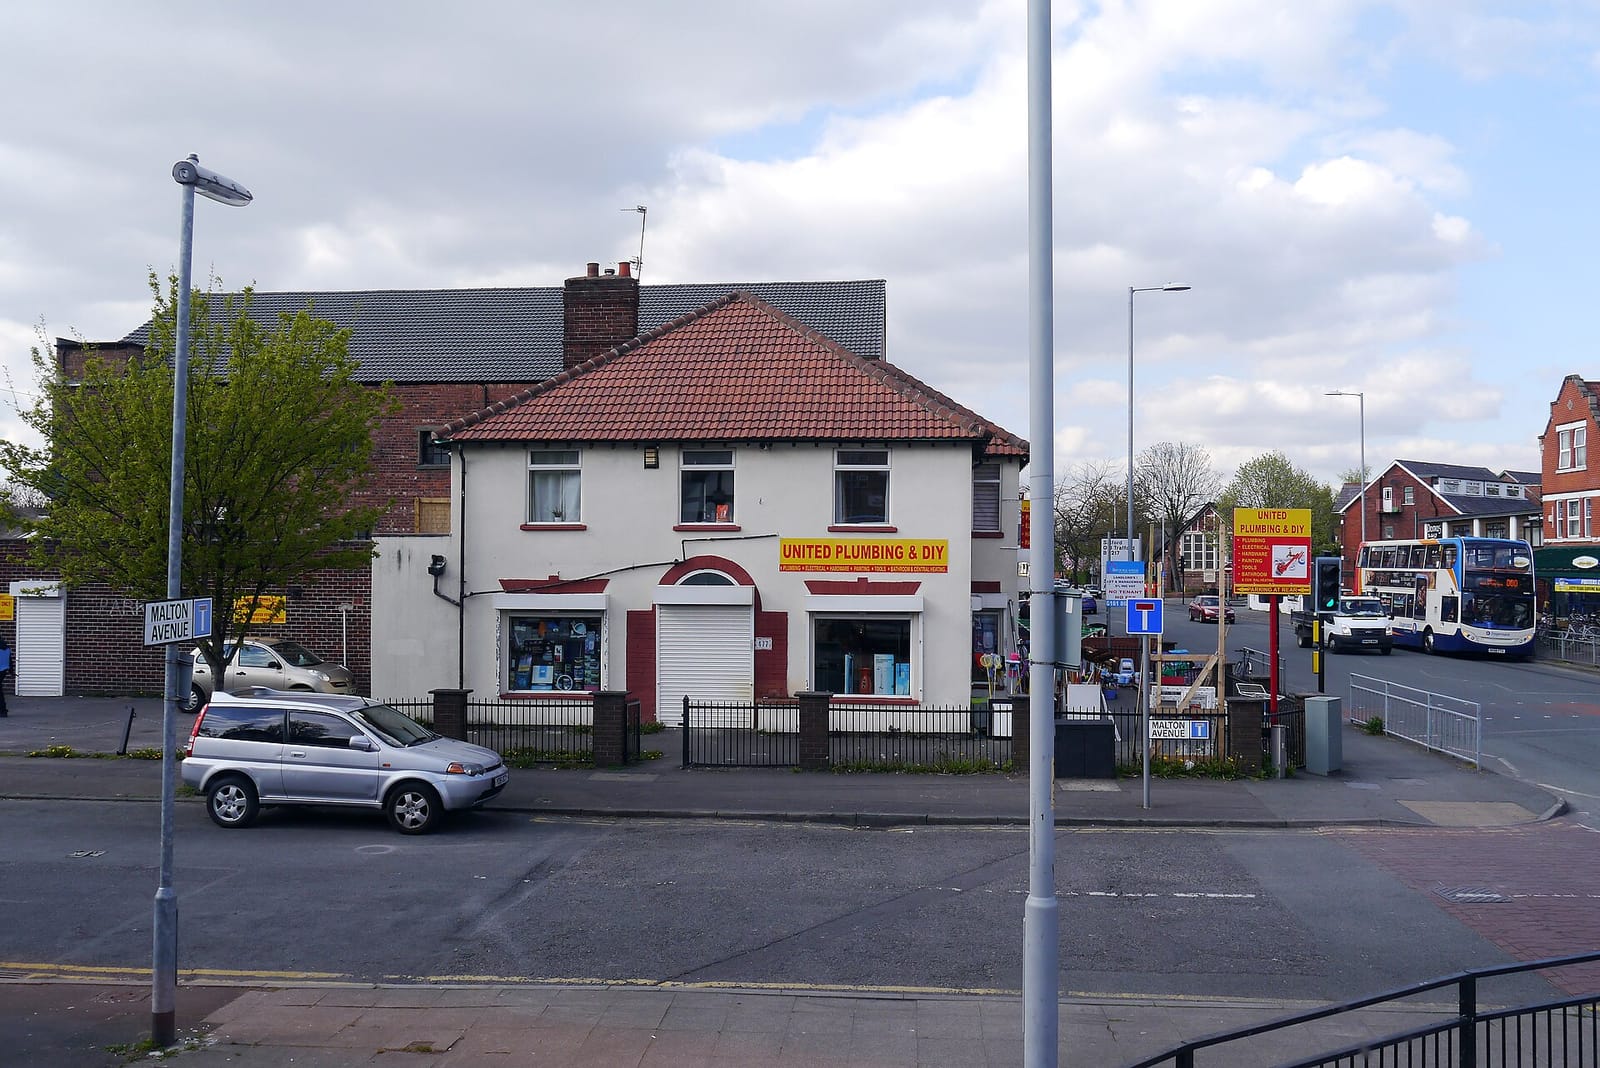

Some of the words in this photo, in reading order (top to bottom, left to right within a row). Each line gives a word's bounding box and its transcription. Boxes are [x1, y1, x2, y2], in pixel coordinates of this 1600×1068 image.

[1257, 511, 1287, 520] UNITED
[1240, 524, 1280, 533] PLUMBING
[1283, 525, 1289, 533] &
[1291, 525, 1305, 533] DIY
[783, 544, 832, 559] UNITED
[835, 544, 904, 560] PLUMBING
[908, 545, 918, 560] &
[922, 545, 945, 560] DIY
[151, 603, 189, 622] MALTON
[151, 621, 189, 641] AVENUE
[1151, 721, 1186, 729] MALTON
[1151, 729, 1186, 737] AVENUE
